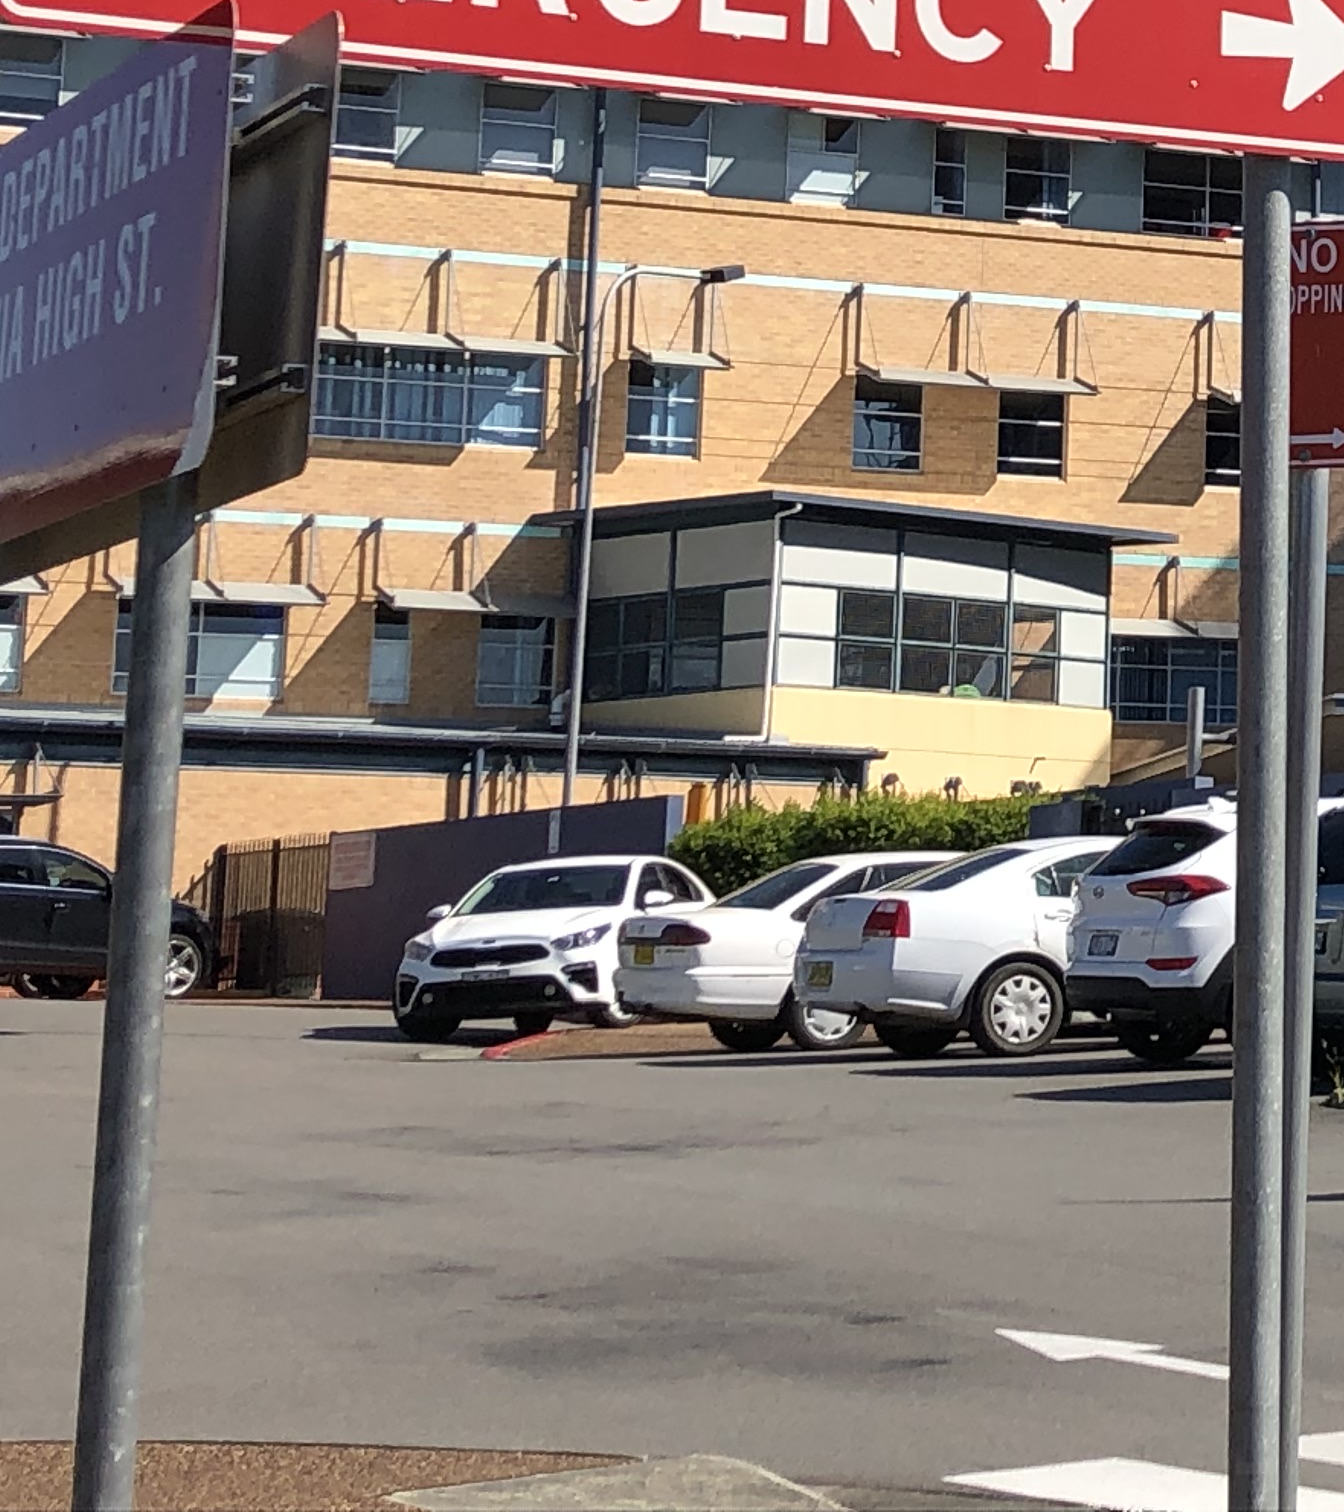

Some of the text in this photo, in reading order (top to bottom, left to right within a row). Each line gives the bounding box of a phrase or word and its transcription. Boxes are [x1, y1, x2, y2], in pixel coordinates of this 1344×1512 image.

[0, 55, 197, 262] DEPARTMENT
[32, 239, 106, 366] HIGH
[114, 211, 162, 325] ST.
[1290, 237, 1338, 274] NO
